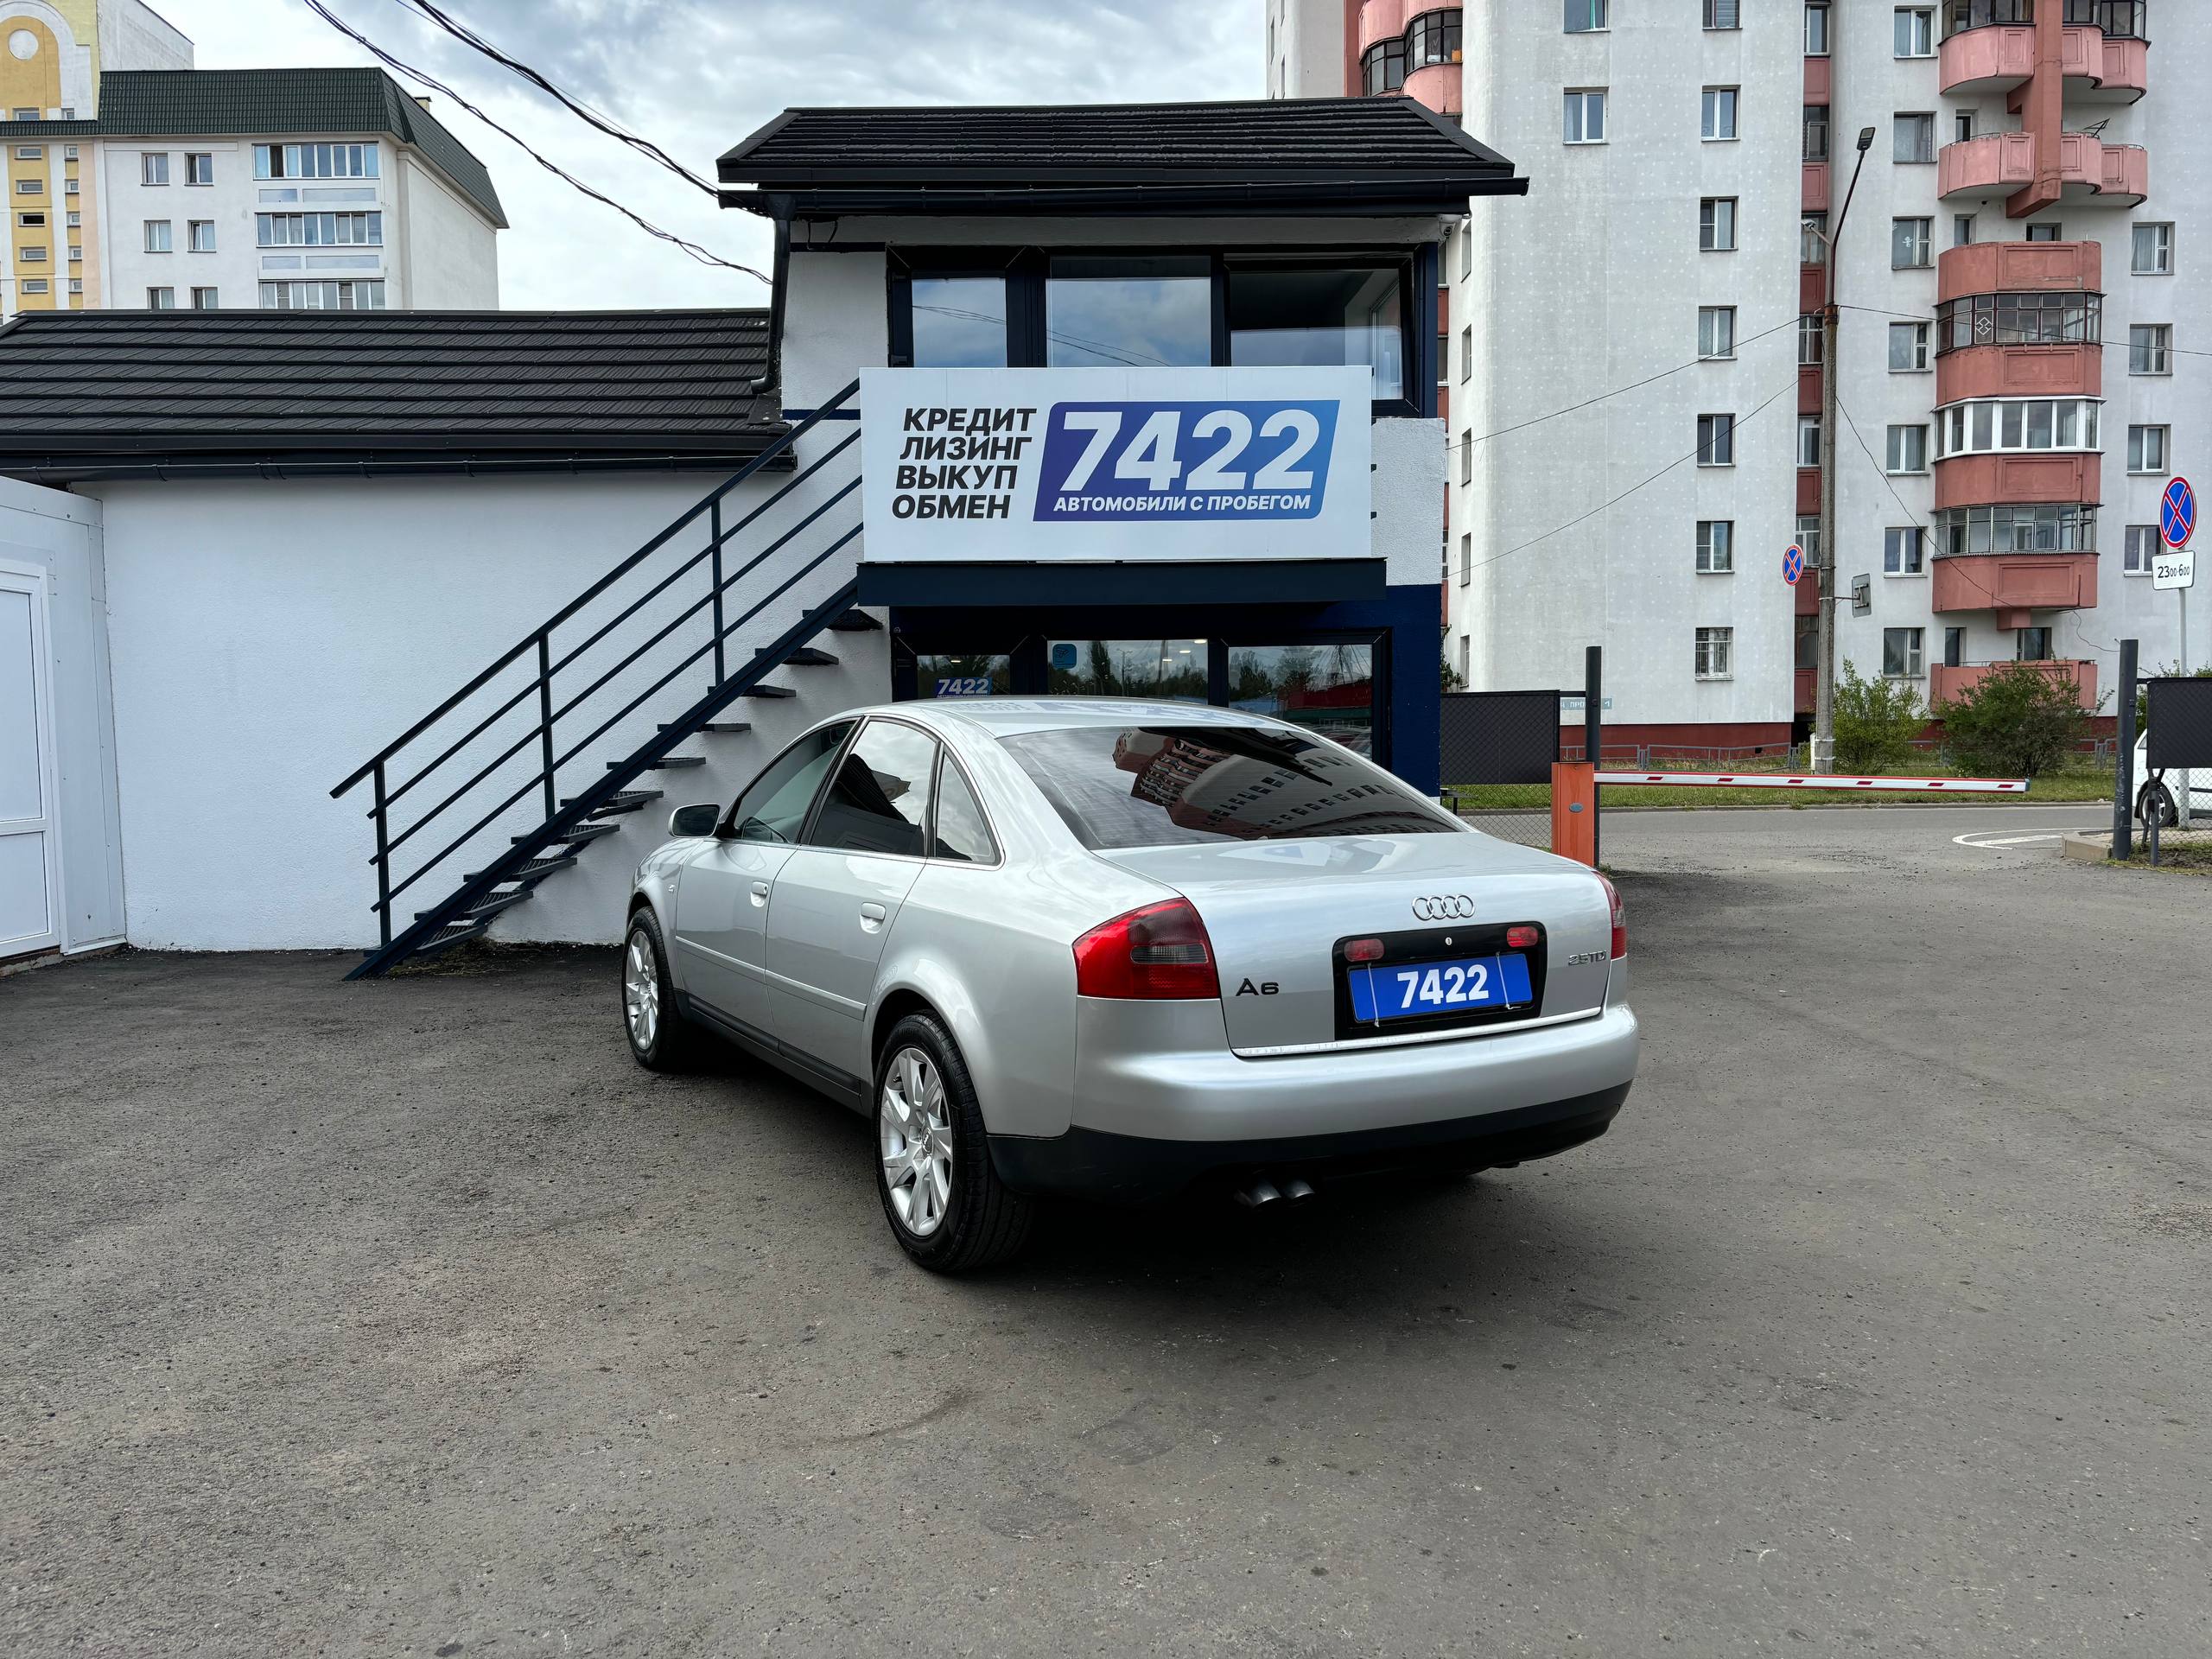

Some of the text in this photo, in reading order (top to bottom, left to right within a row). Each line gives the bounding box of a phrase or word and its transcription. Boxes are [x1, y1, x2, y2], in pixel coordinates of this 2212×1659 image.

[903, 408, 1037, 436] КРЕДИТ
[899, 436, 1033, 461] ЛИЗИНГ
[1059, 409, 1320, 492] 7422
[895, 465, 1018, 490] ВЫКУП
[892, 494, 1011, 519] ОБМЕН
[1052, 494, 1311, 512] АВТОМОБИЛИ С ПРОБЕГОМ
[938, 678, 989, 695] 7422
[1235, 977, 1280, 996] A6
[1397, 963, 1490, 1008] 7422
